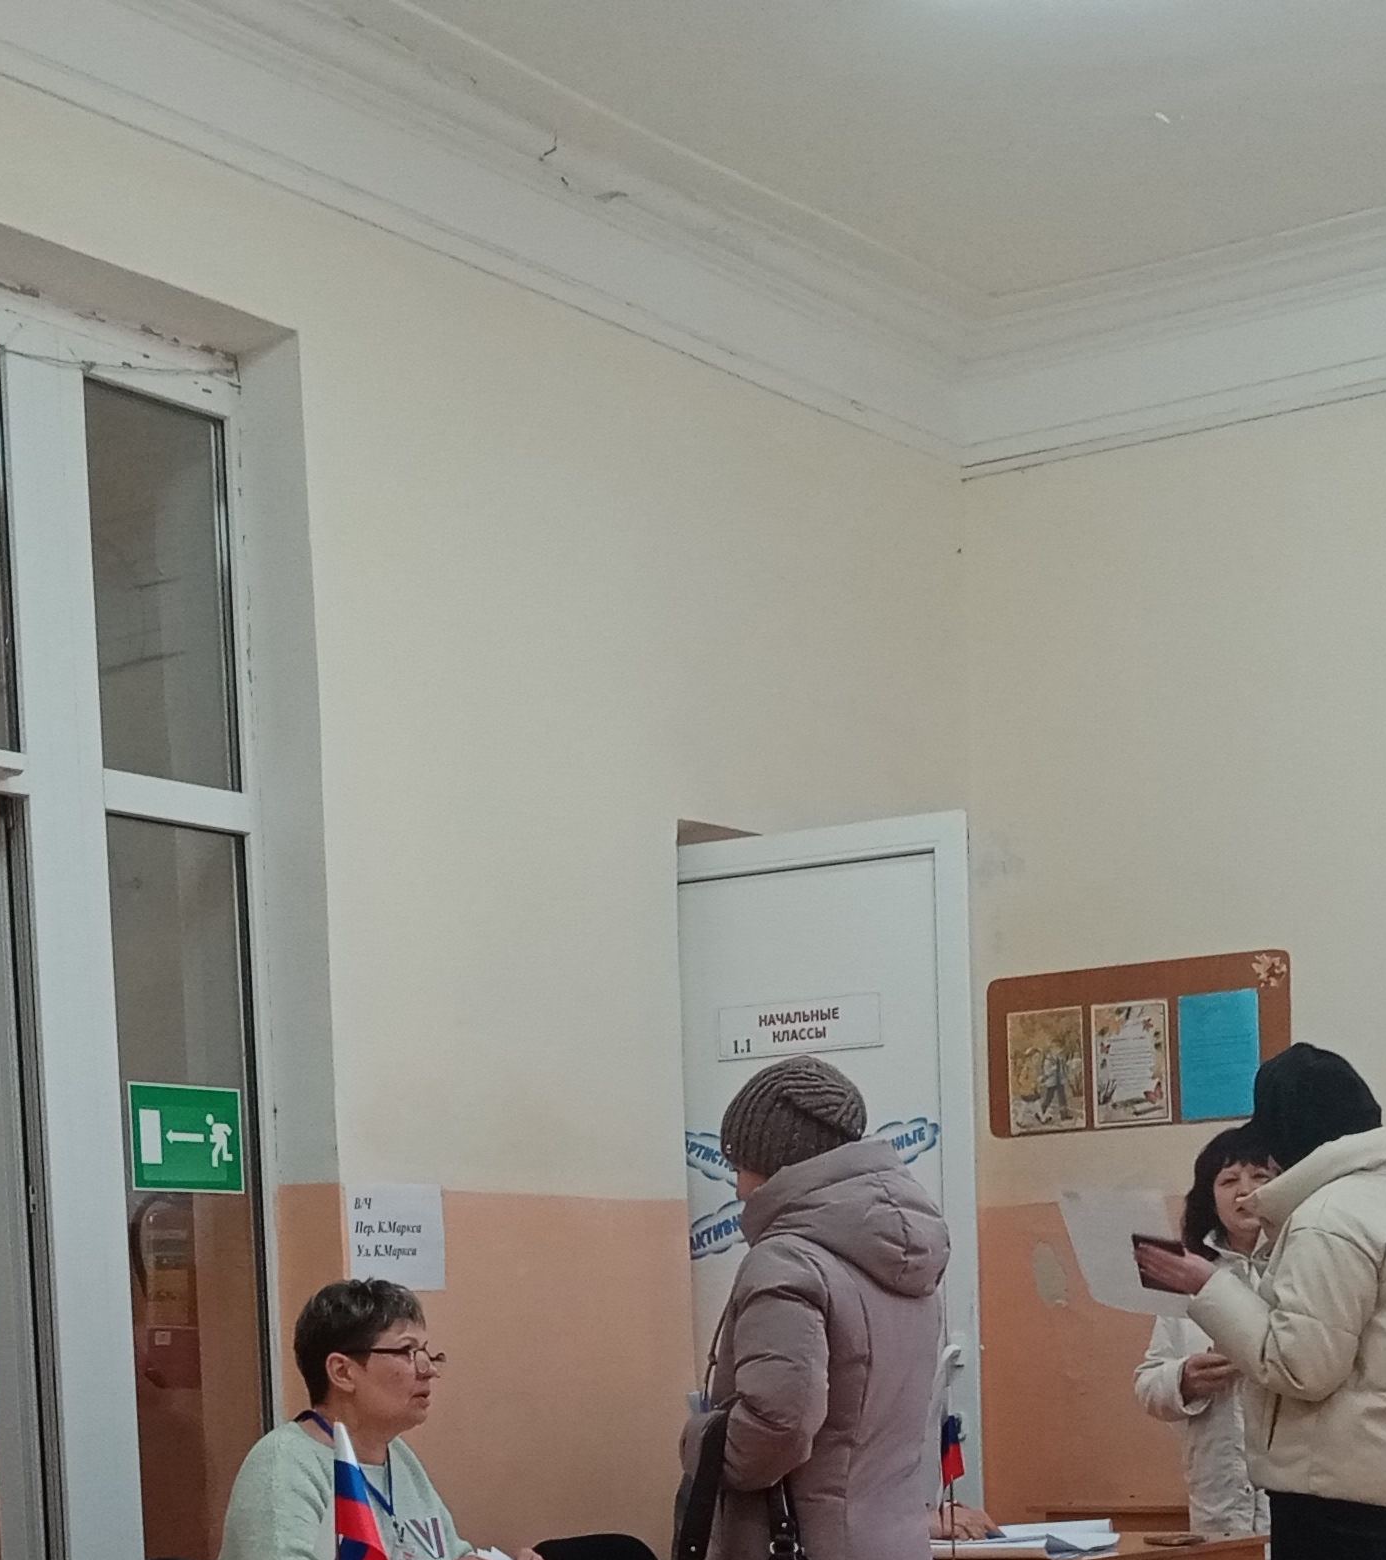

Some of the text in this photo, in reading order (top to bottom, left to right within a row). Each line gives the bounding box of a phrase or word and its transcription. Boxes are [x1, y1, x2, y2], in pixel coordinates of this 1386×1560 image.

[758, 1006, 840, 1027] НАЧАЛЬНЫЕ
[772, 1026, 826, 1043] КЛАССЫ
[733, 1038, 751, 1054] 1.1
